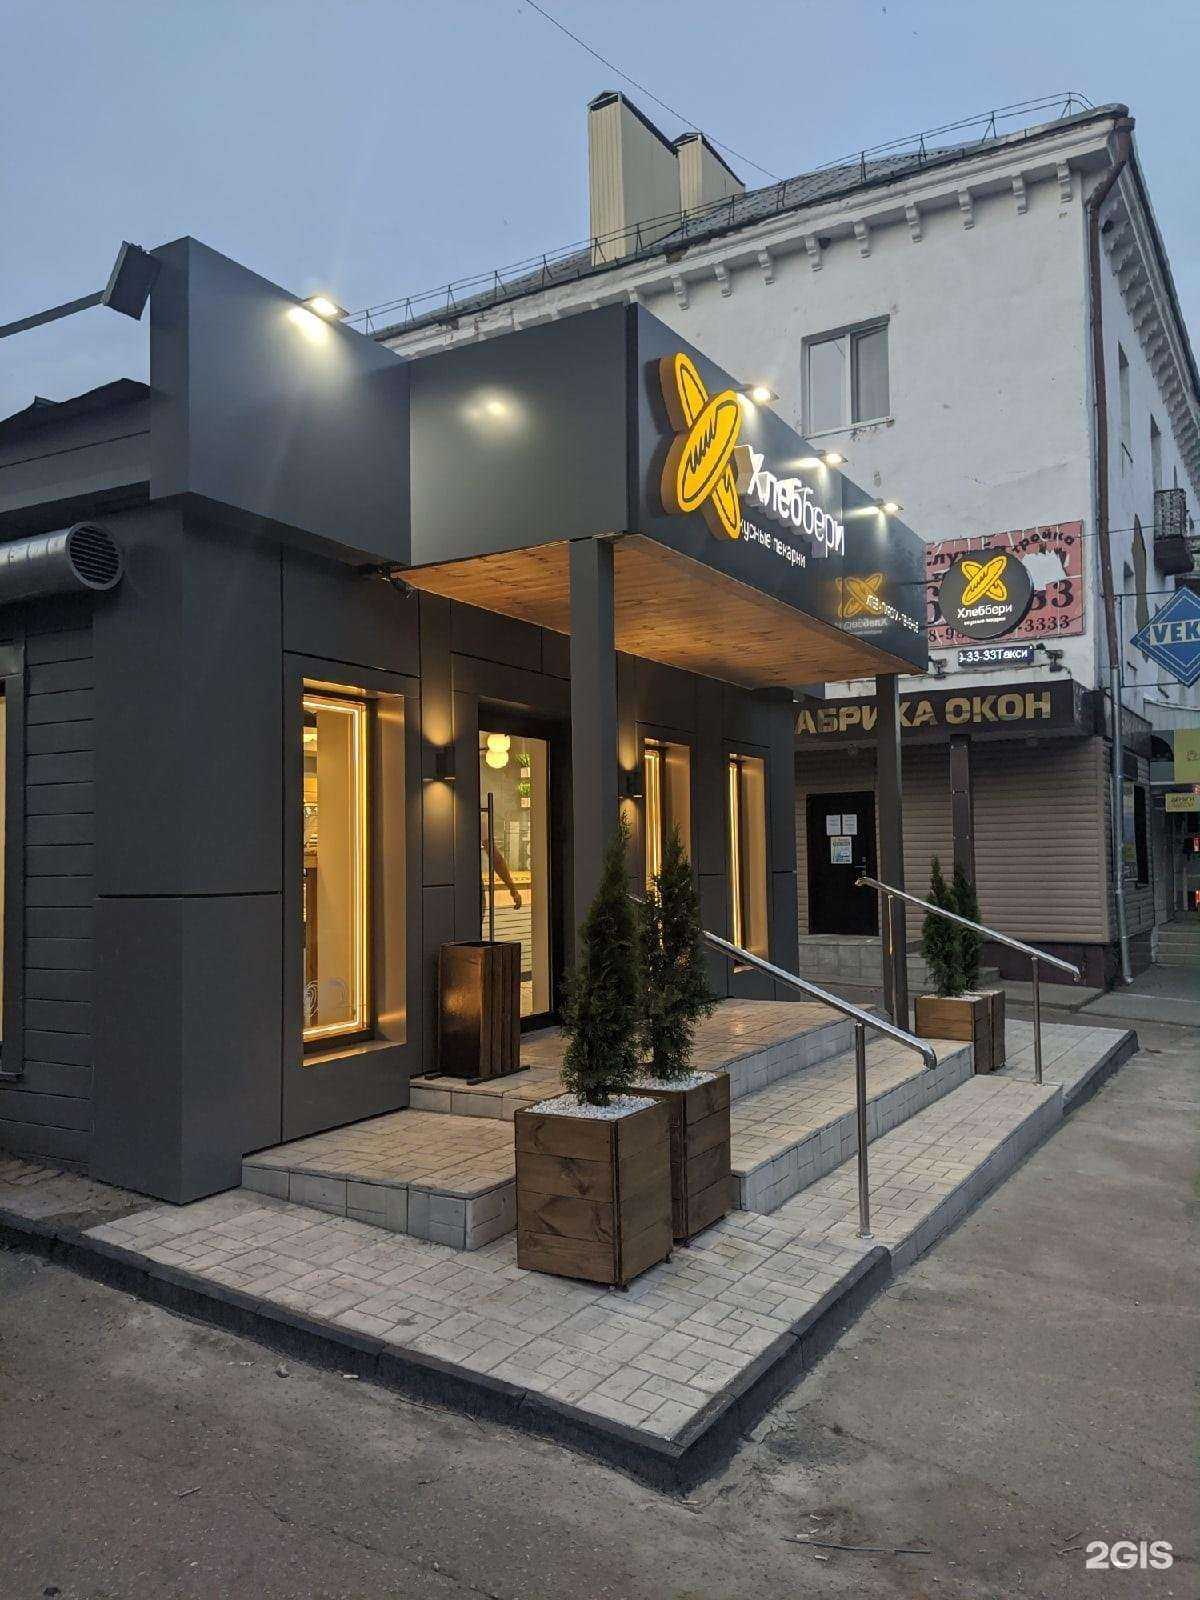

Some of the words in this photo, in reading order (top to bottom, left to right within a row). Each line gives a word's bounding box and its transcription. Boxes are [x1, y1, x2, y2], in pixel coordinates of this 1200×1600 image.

[747, 445, 844, 558] Хлеббери
[957, 603, 1013, 619] Хлеббери
[795, 699, 938, 735] АБРИКА
[944, 691, 1051, 725] ОКОН
